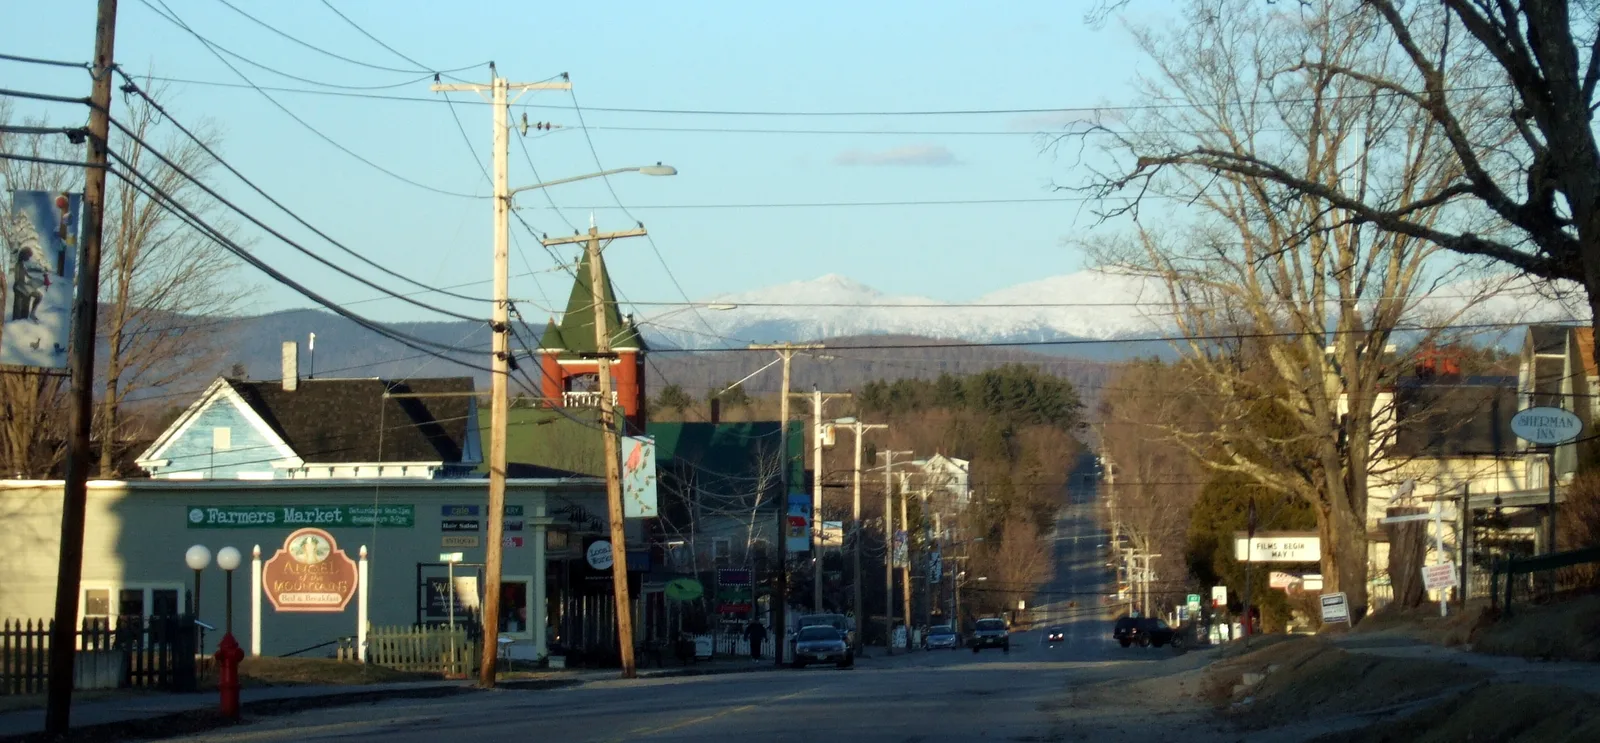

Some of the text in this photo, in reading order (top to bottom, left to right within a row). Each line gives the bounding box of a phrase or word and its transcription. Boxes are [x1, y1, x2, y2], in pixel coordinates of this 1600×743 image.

[1518, 415, 1574, 428] SHERMAN
[1537, 428, 1556, 439] INN
[206, 508, 343, 523] Farmers Market
[590, 544, 612, 557] Local
[283, 561, 340, 574] ANGEL
[305, 594, 339, 602] Breakfast
